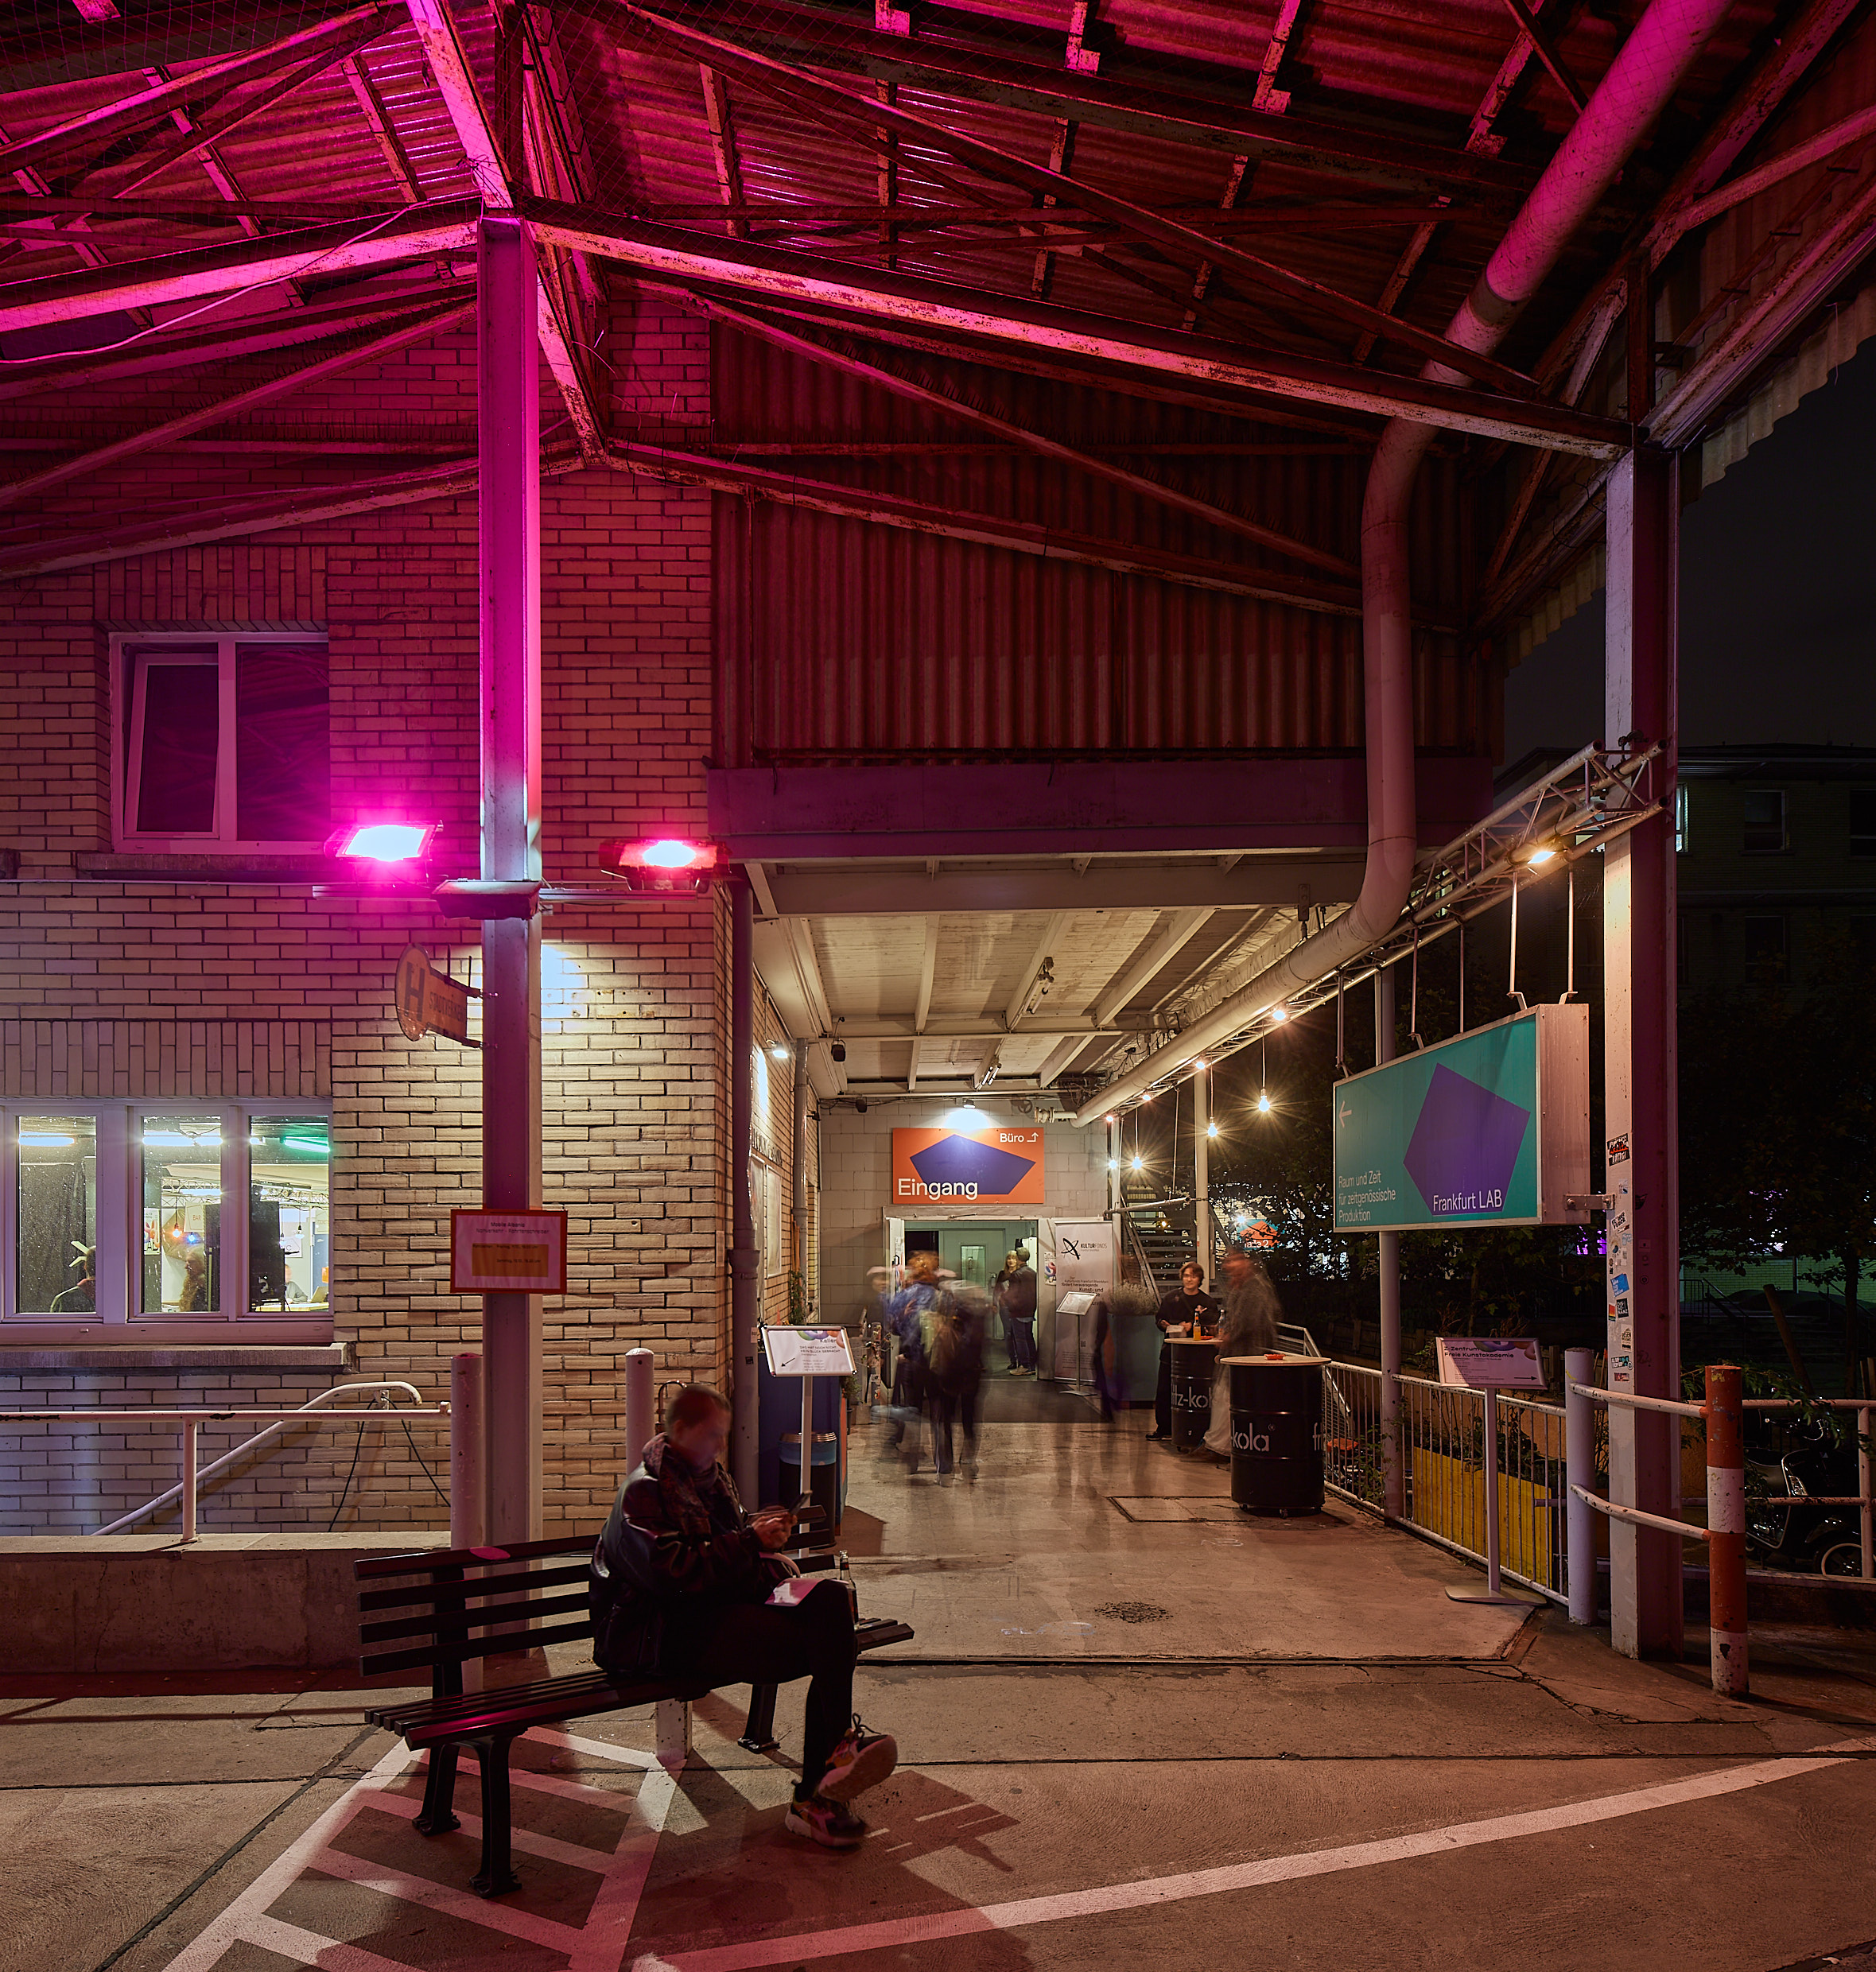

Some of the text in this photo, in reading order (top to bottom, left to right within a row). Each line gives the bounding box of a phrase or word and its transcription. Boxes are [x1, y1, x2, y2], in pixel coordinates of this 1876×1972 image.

[404, 961, 425, 1023] H
[1000, 1132, 1024, 1143] Büro
[1338, 1170, 1381, 1188] Raum und Zeit
[898, 1178, 978, 1201] Eingang
[1338, 1186, 1396, 1207] für zeitgenössische
[1433, 1189, 1502, 1212] Frankfurt LAB
[1338, 1208, 1371, 1222] Produktion
[1263, 1239, 1269, 1248] 2
